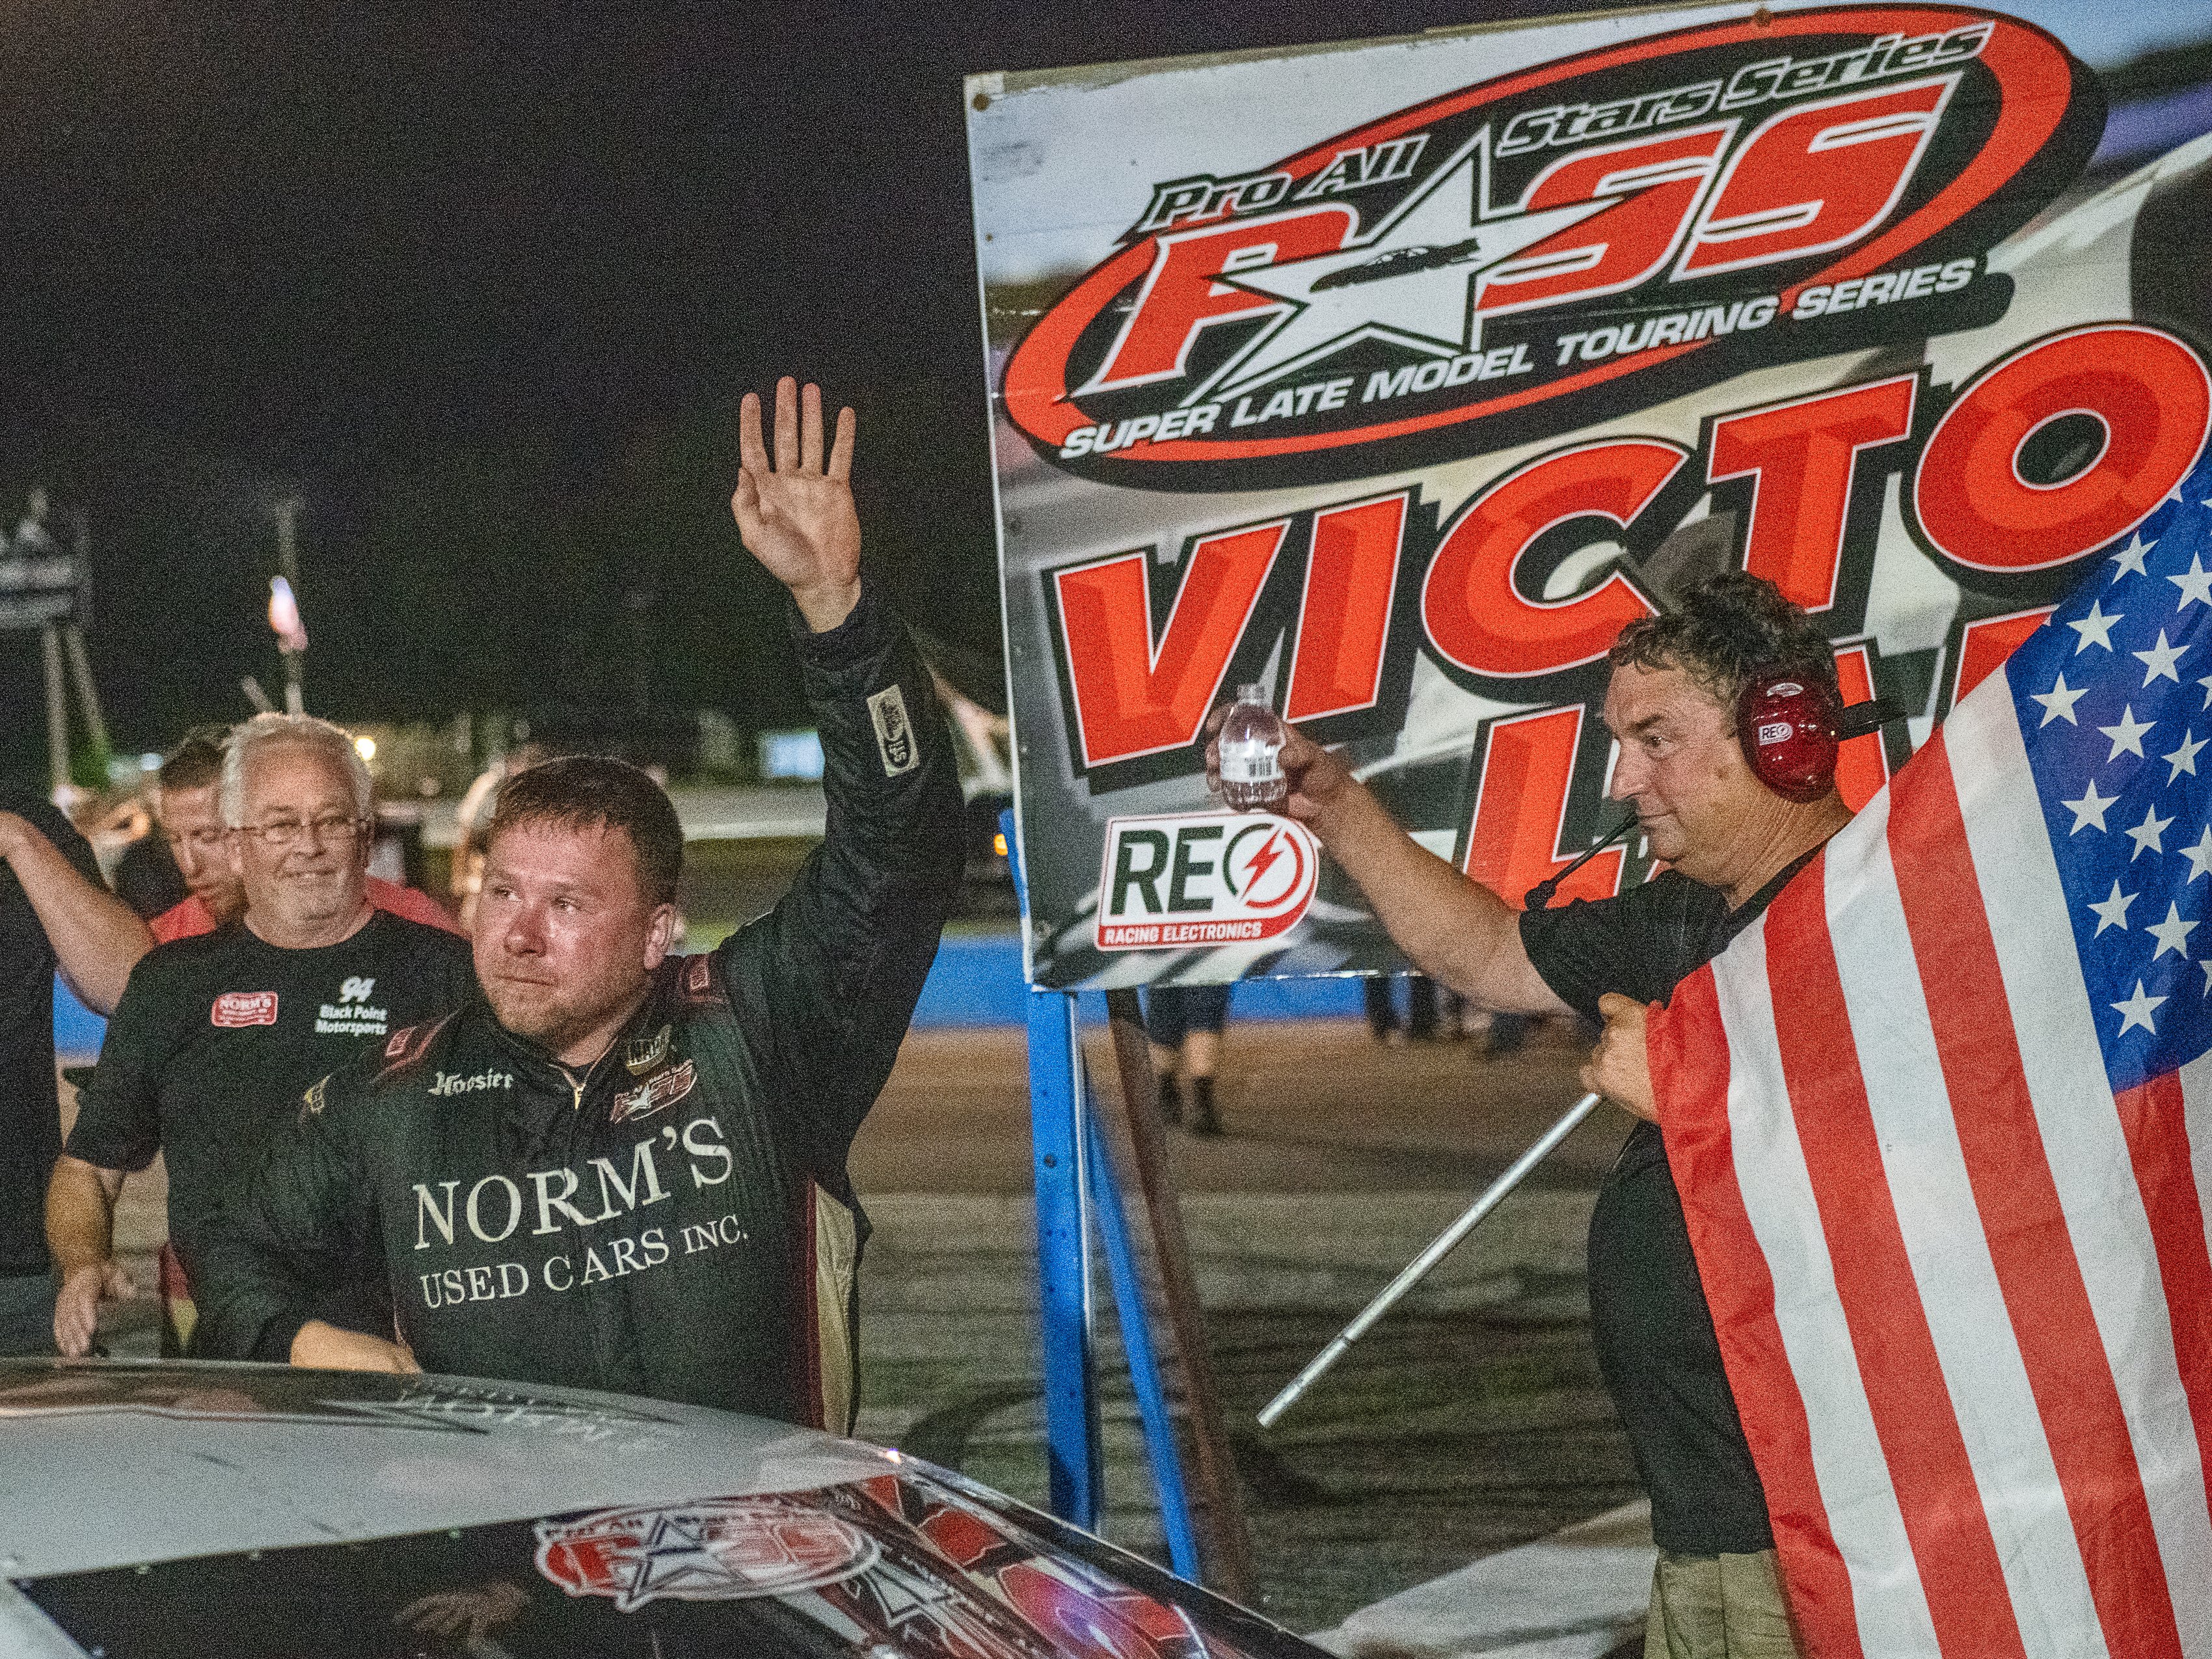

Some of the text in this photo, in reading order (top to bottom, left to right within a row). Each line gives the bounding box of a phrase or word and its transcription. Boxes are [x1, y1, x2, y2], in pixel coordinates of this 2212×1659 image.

[1140, 21, 1996, 232] Pro All Stars Series
[1060, 258, 1976, 459] SUPER LATE MODEL TOURING SERIES
[1104, 922, 1262, 945] RACING ELECTRONICS
[315, 1018, 388, 1037] Motorsports
[319, 1004, 388, 1022] Black Point
[427, 1067, 515, 1098] Hoosier
[412, 1116, 734, 1250] NORM'S
[420, 1214, 749, 1310] USED CARS INC.
